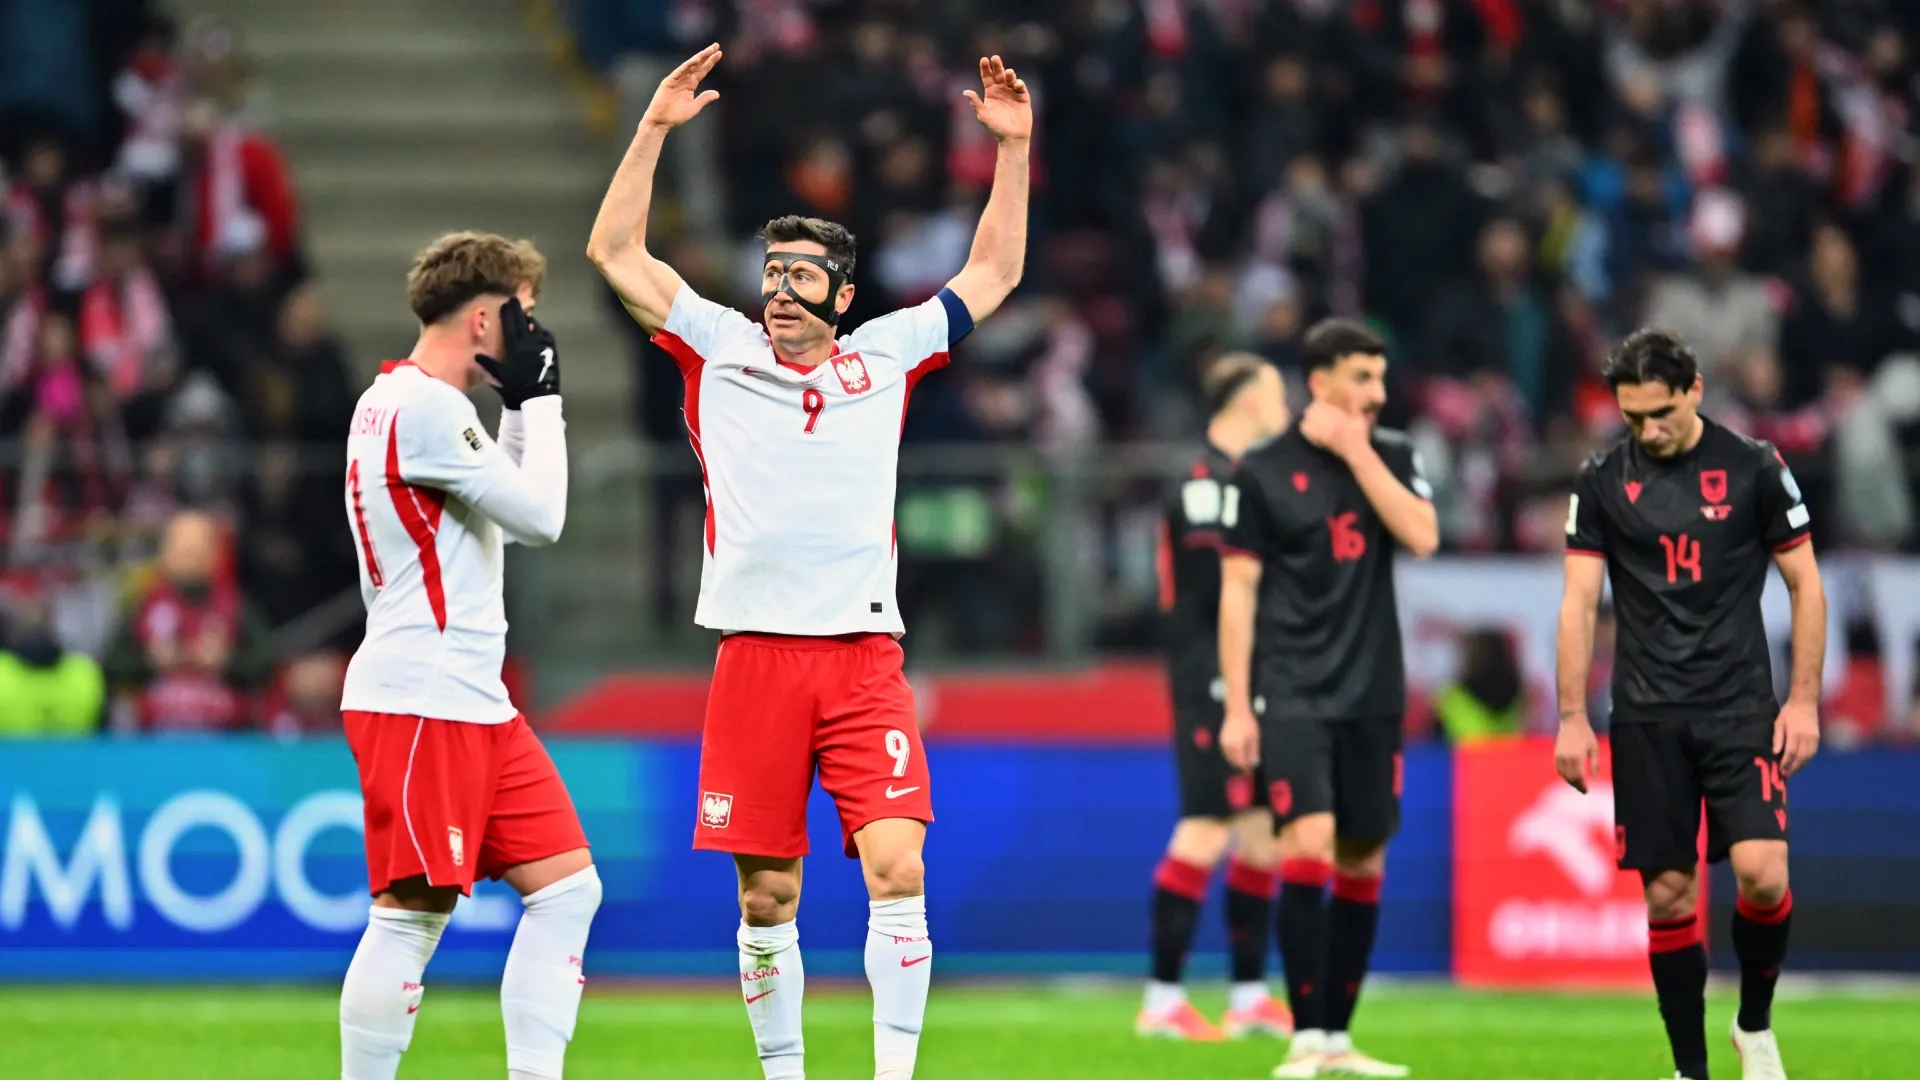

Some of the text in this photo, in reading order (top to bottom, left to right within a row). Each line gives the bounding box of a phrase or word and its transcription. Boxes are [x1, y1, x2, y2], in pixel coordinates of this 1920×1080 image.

[803, 388, 826, 434] 9
[1327, 512, 1368, 562] 16
[1658, 533, 1702, 584] 14
[885, 729, 910, 777] 9
